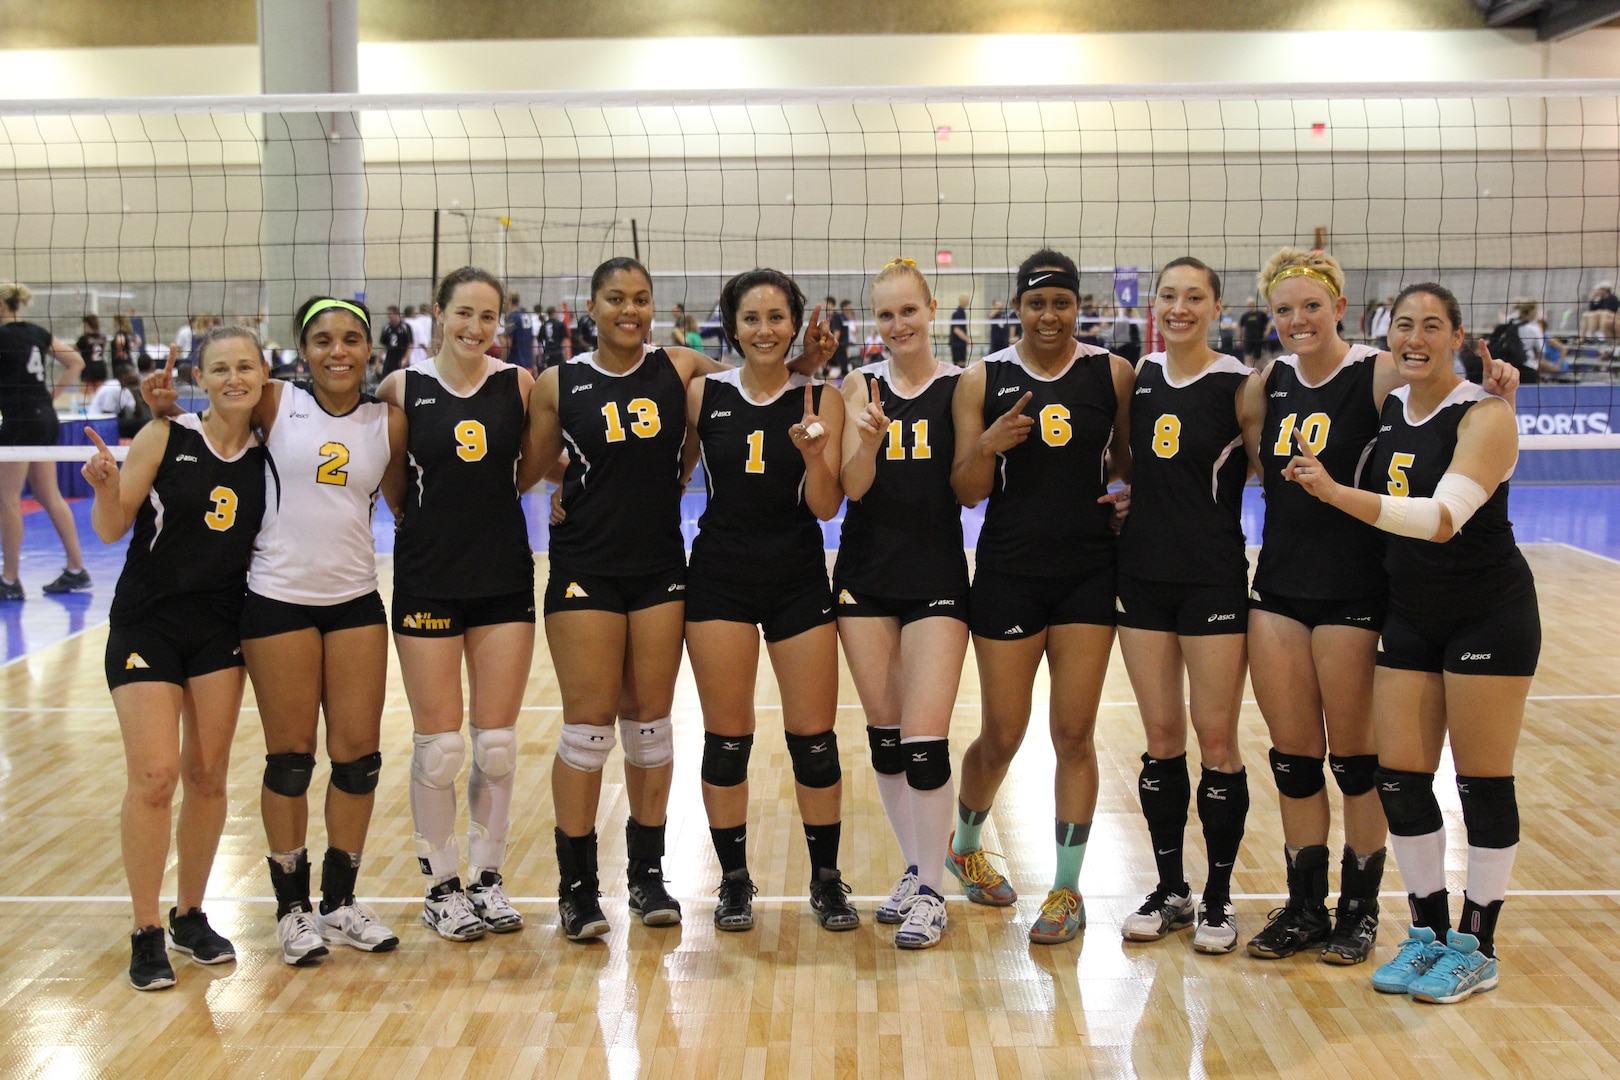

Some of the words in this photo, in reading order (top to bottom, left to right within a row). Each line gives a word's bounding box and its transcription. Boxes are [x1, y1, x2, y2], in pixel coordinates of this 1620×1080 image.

[1121, 286, 1132, 303] 4
[26, 345, 44, 382] 4
[454, 419, 488, 463] 9
[600, 398, 661, 443] 13
[886, 418, 932, 461] 11
[1039, 403, 1073, 448] 6
[1152, 413, 1181, 459] 8
[1273, 412, 1332, 457] 10
[315, 441, 350, 487] 2
[745, 430, 765, 474] 1
[1386, 451, 1416, 497] 5
[204, 485, 239, 532] 3
[1217, 613, 1236, 621] asics
[1469, 652, 1491, 661] asics
